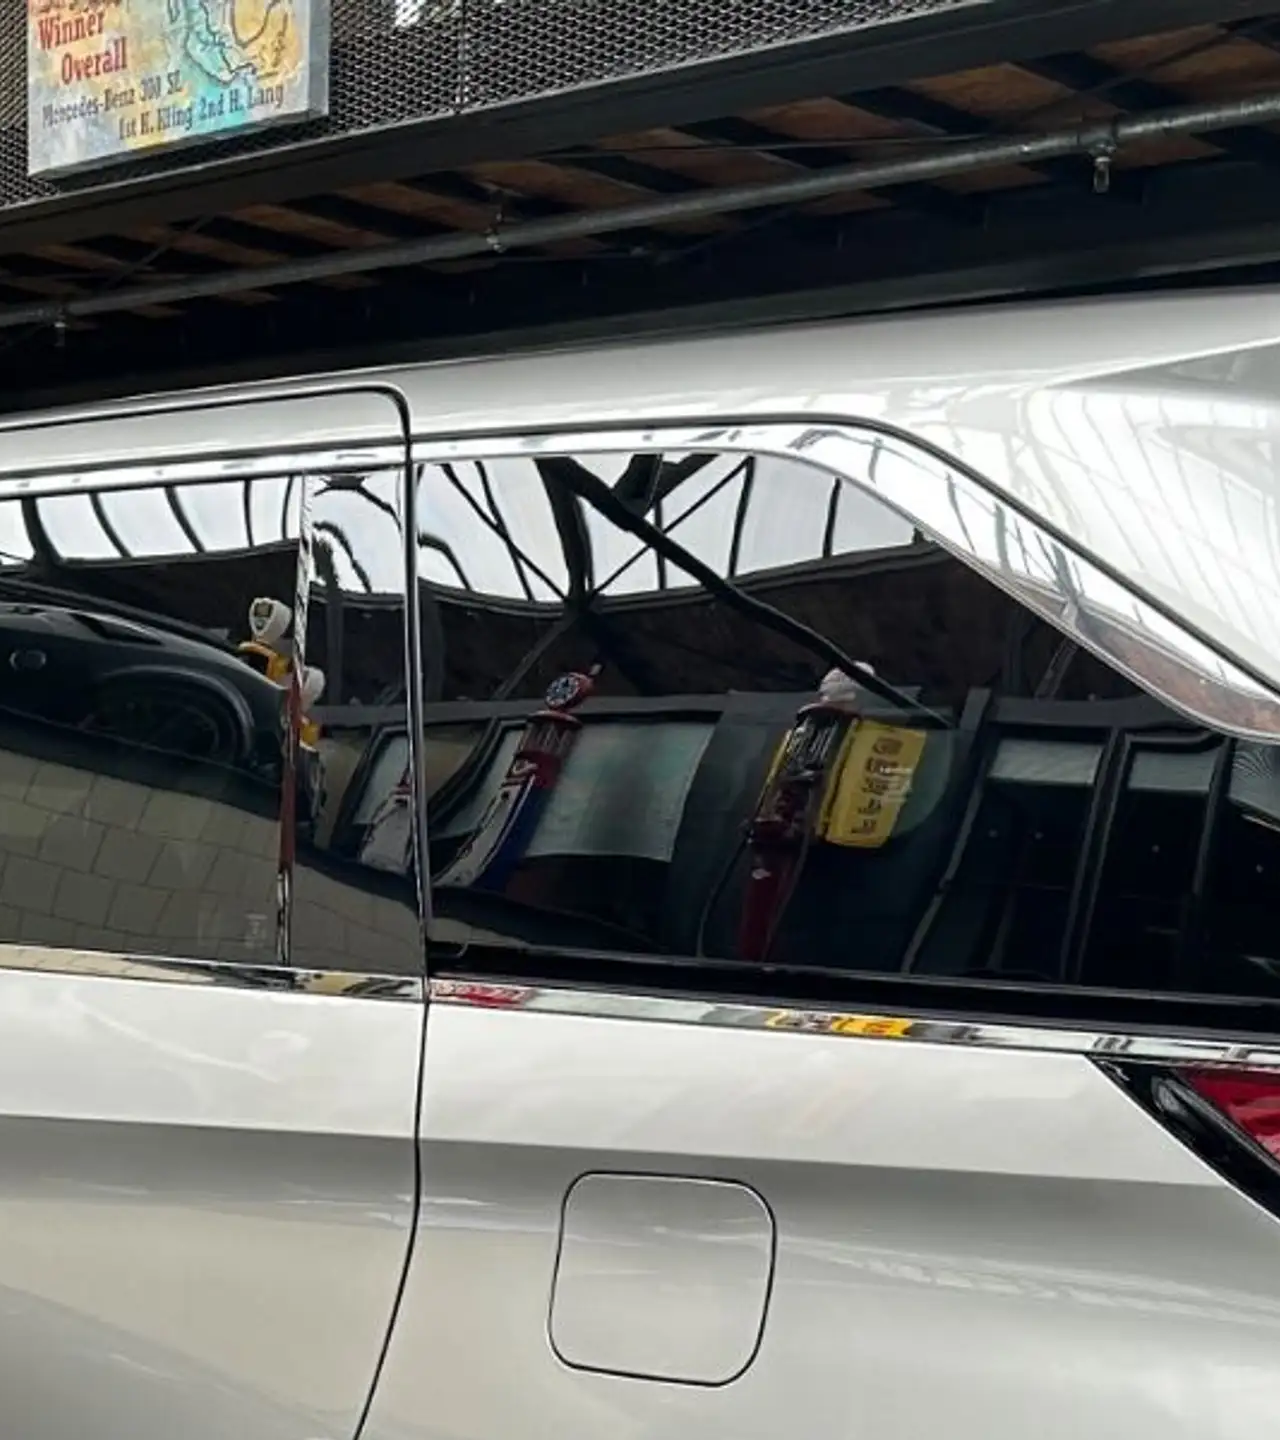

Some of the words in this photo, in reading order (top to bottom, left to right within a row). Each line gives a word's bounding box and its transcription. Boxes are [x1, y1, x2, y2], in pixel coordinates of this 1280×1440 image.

[38, 11, 104, 50] Winner
[61, 36, 127, 84] Overall
[199, 92, 224, 121] 2nd
[229, 88, 244, 114] H.
[248, 84, 284, 110] Lang
